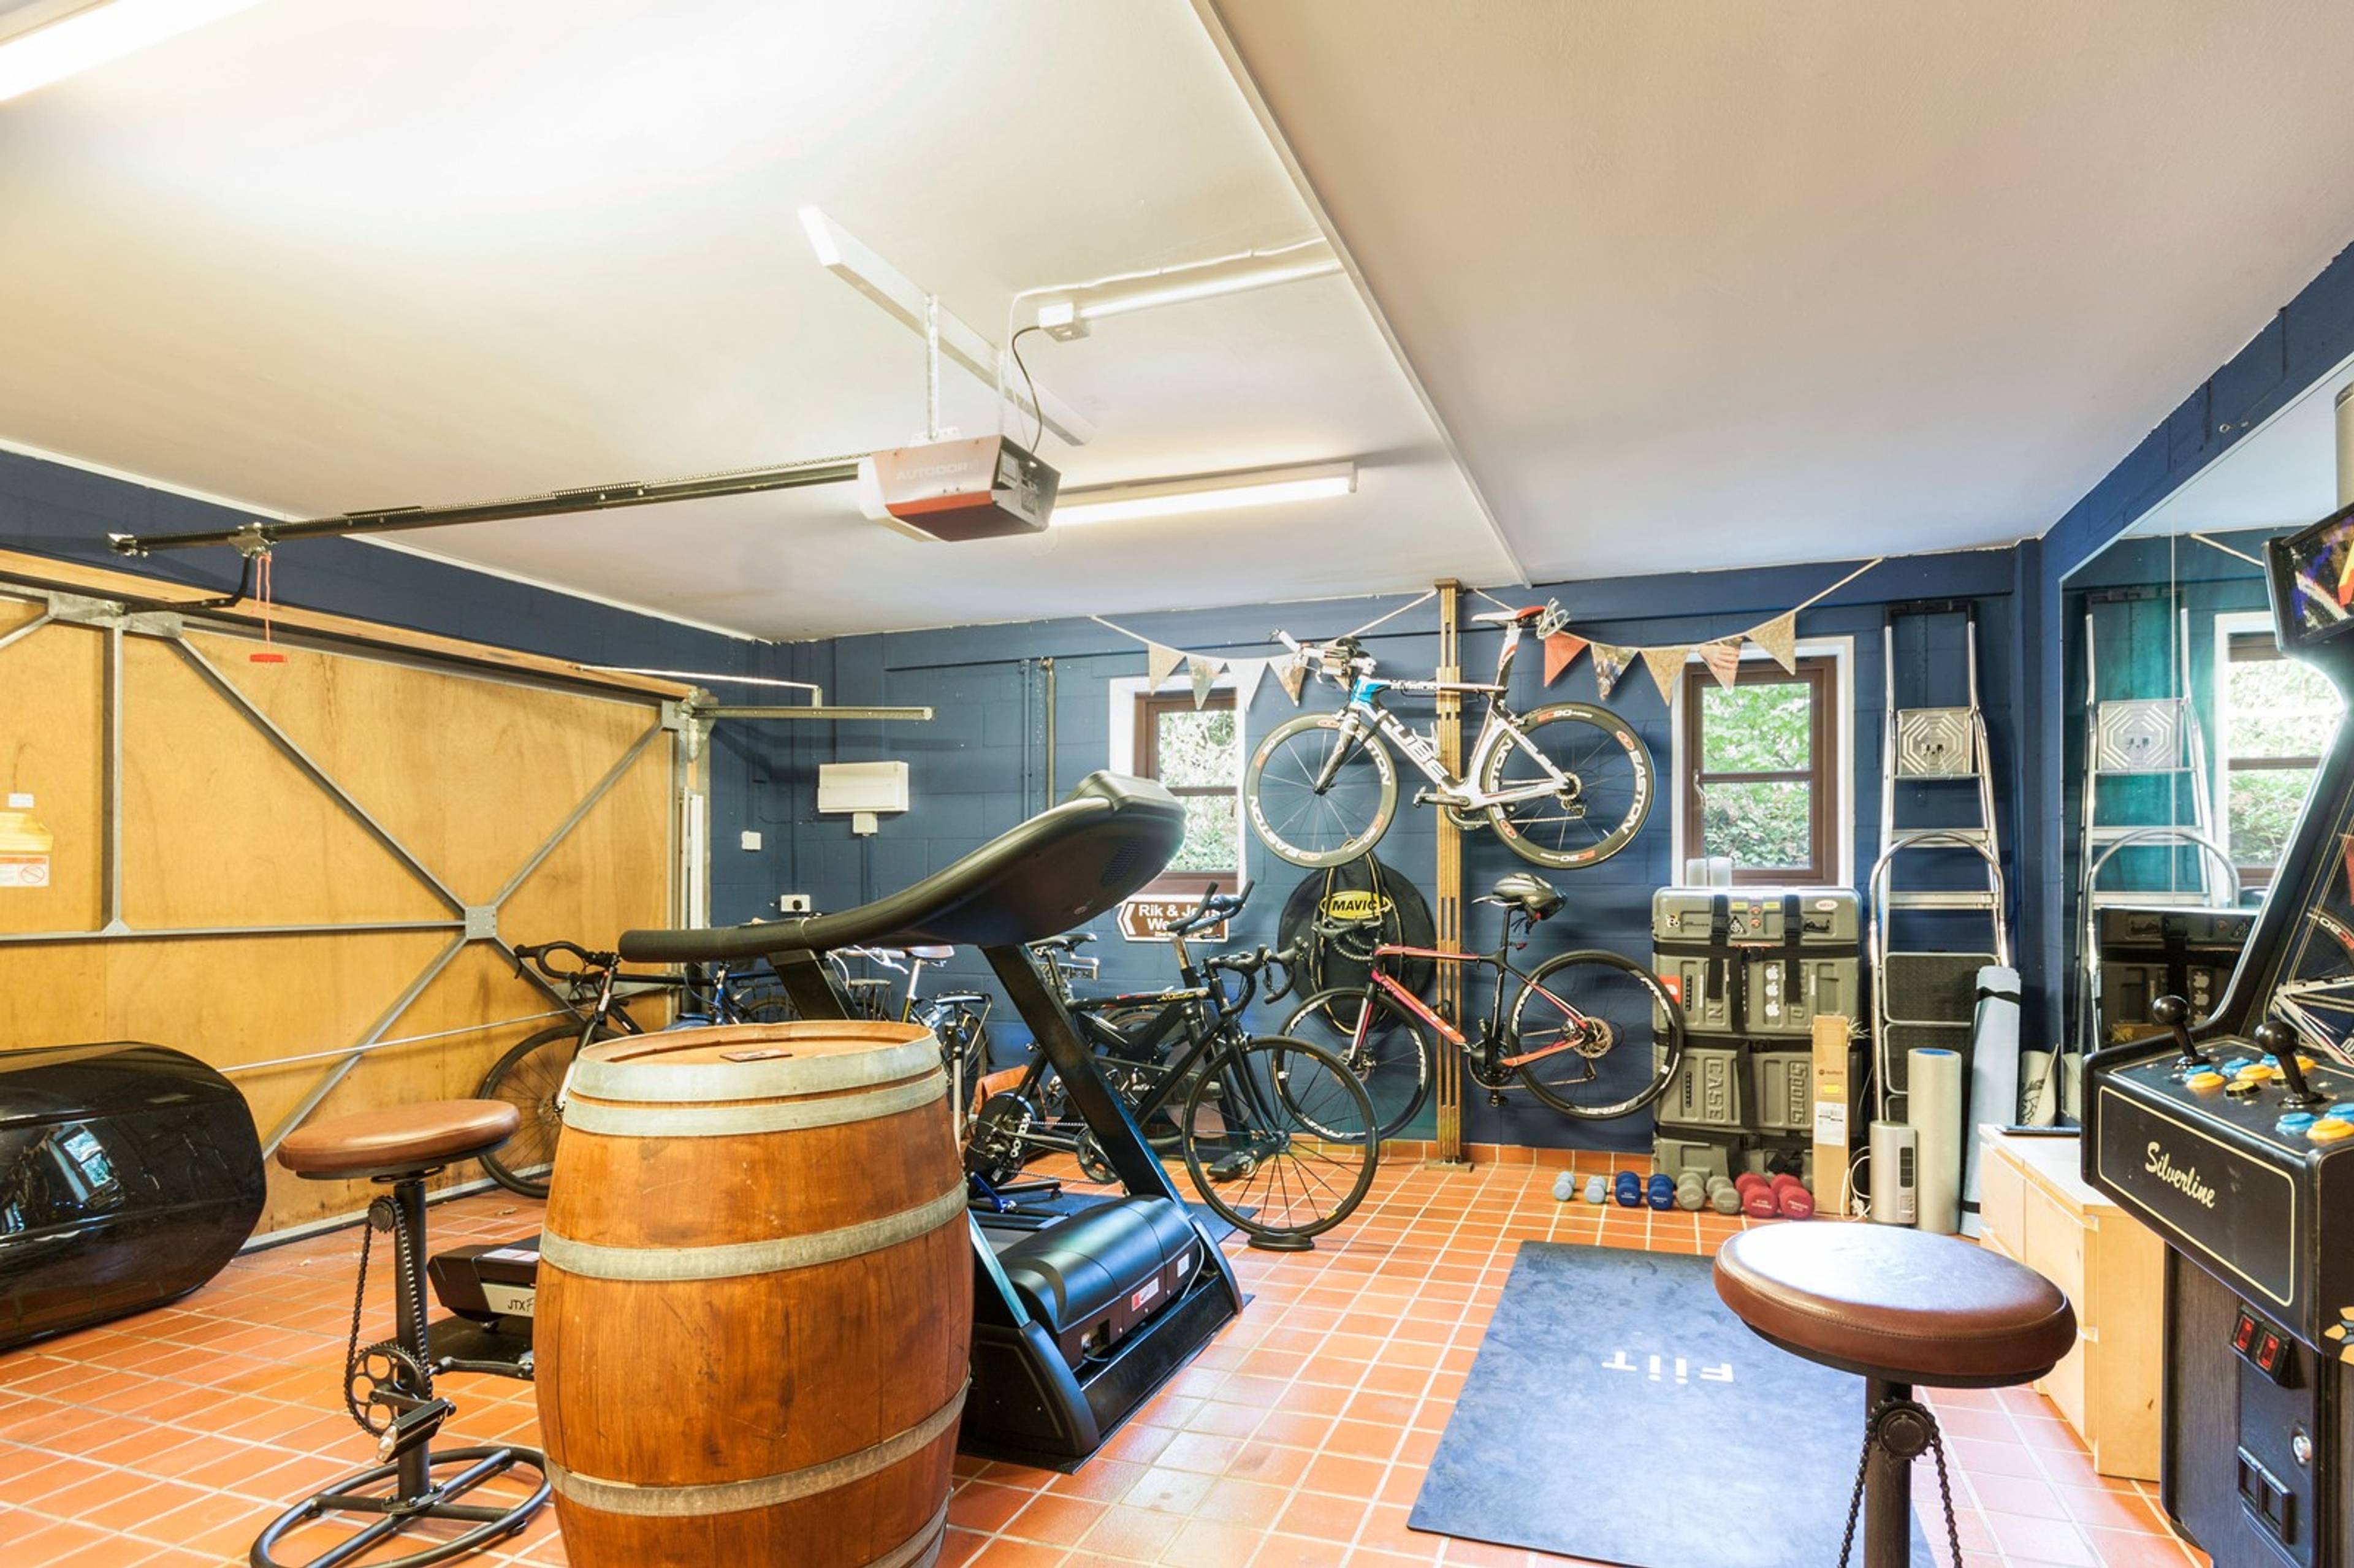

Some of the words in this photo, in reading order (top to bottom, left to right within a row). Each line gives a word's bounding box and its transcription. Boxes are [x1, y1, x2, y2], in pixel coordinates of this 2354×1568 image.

[1490, 739, 1514, 820] ESTON
[1620, 750, 1647, 835] EASTON
[1249, 796, 1300, 858] EASTON
[1138, 904, 1164, 917] Rik
[1166, 904, 1179, 917] &
[1332, 900, 1377, 911] MAVIC
[1707, 1059, 1724, 1120] CASE
[1788, 1062, 1807, 1124] Sports
[1010, 1113, 1031, 1157] waoo
[2145, 1141, 2215, 1208] Silverline
[508, 1299, 525, 1311] JTX
